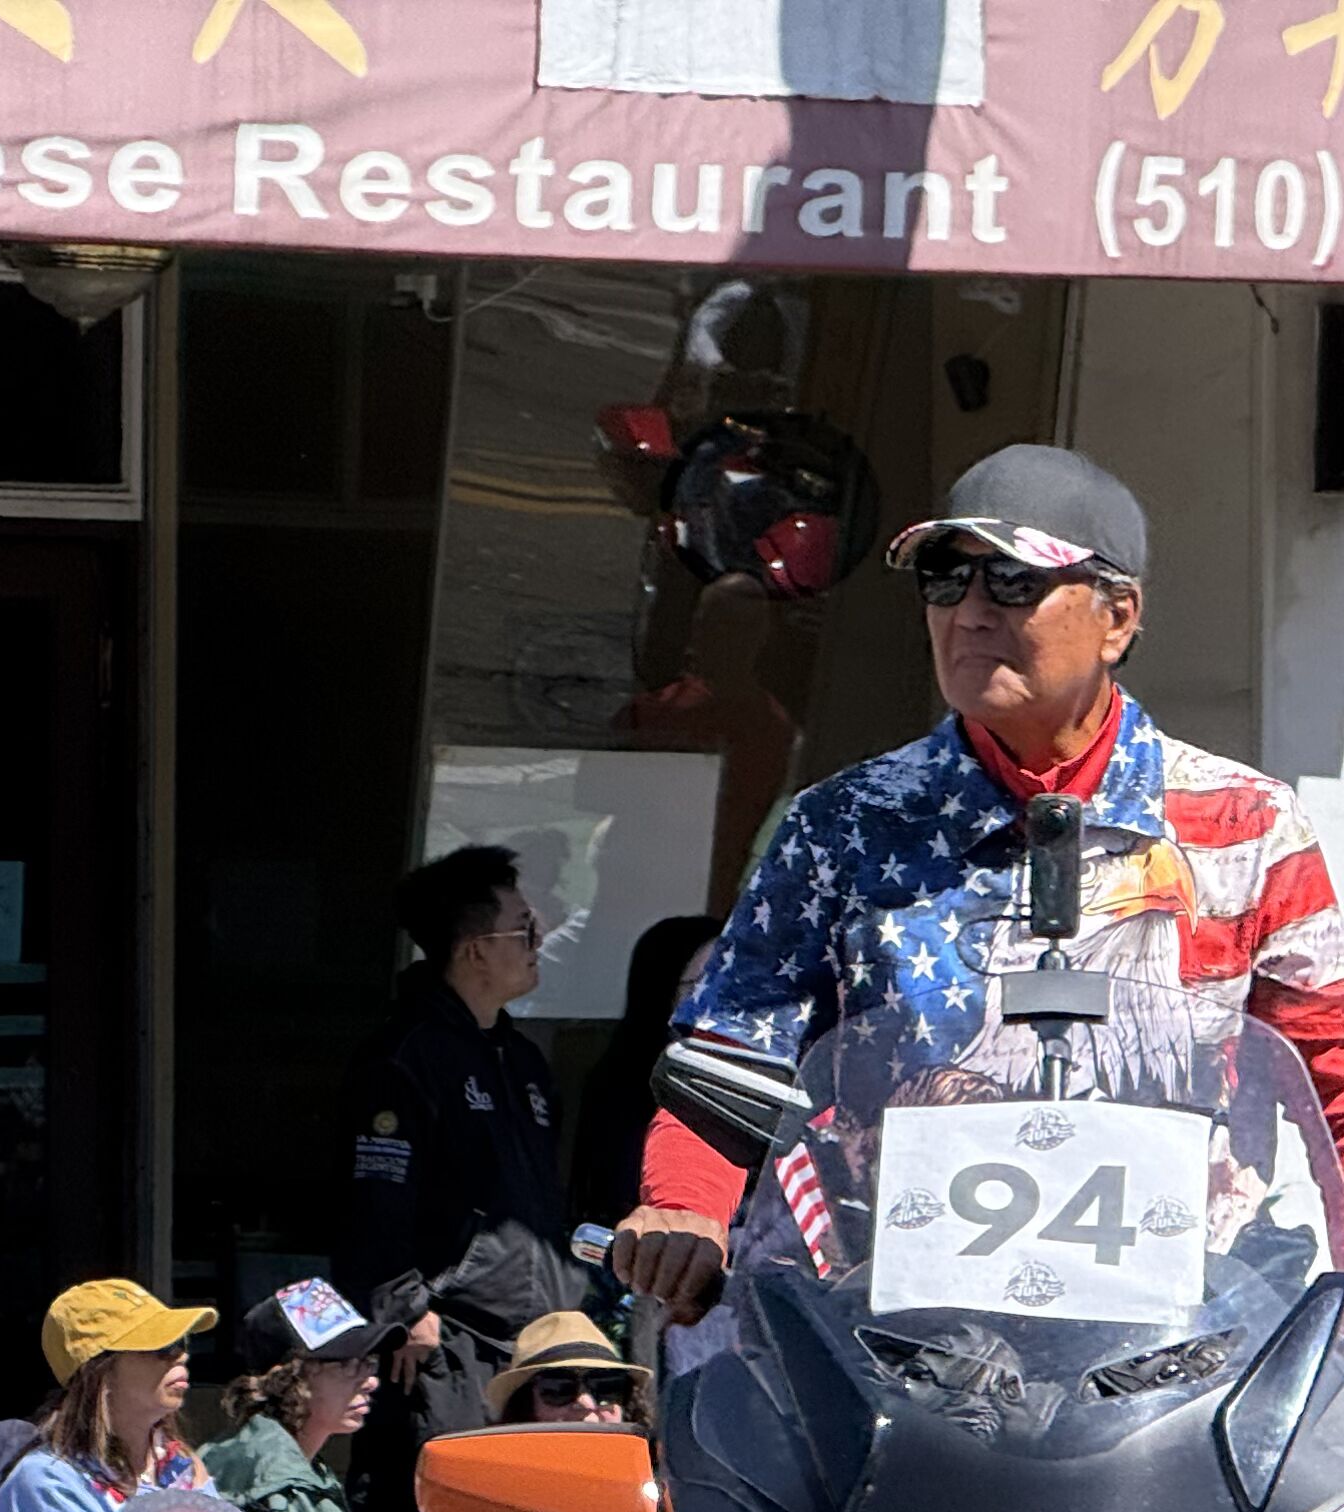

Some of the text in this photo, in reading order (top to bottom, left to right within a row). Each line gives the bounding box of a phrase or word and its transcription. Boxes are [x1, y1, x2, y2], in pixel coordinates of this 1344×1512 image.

[233, 123, 1007, 244] Restaurant
[1095, 141, 1343, 266] (510)
[949, 1162, 1137, 1266] 94
